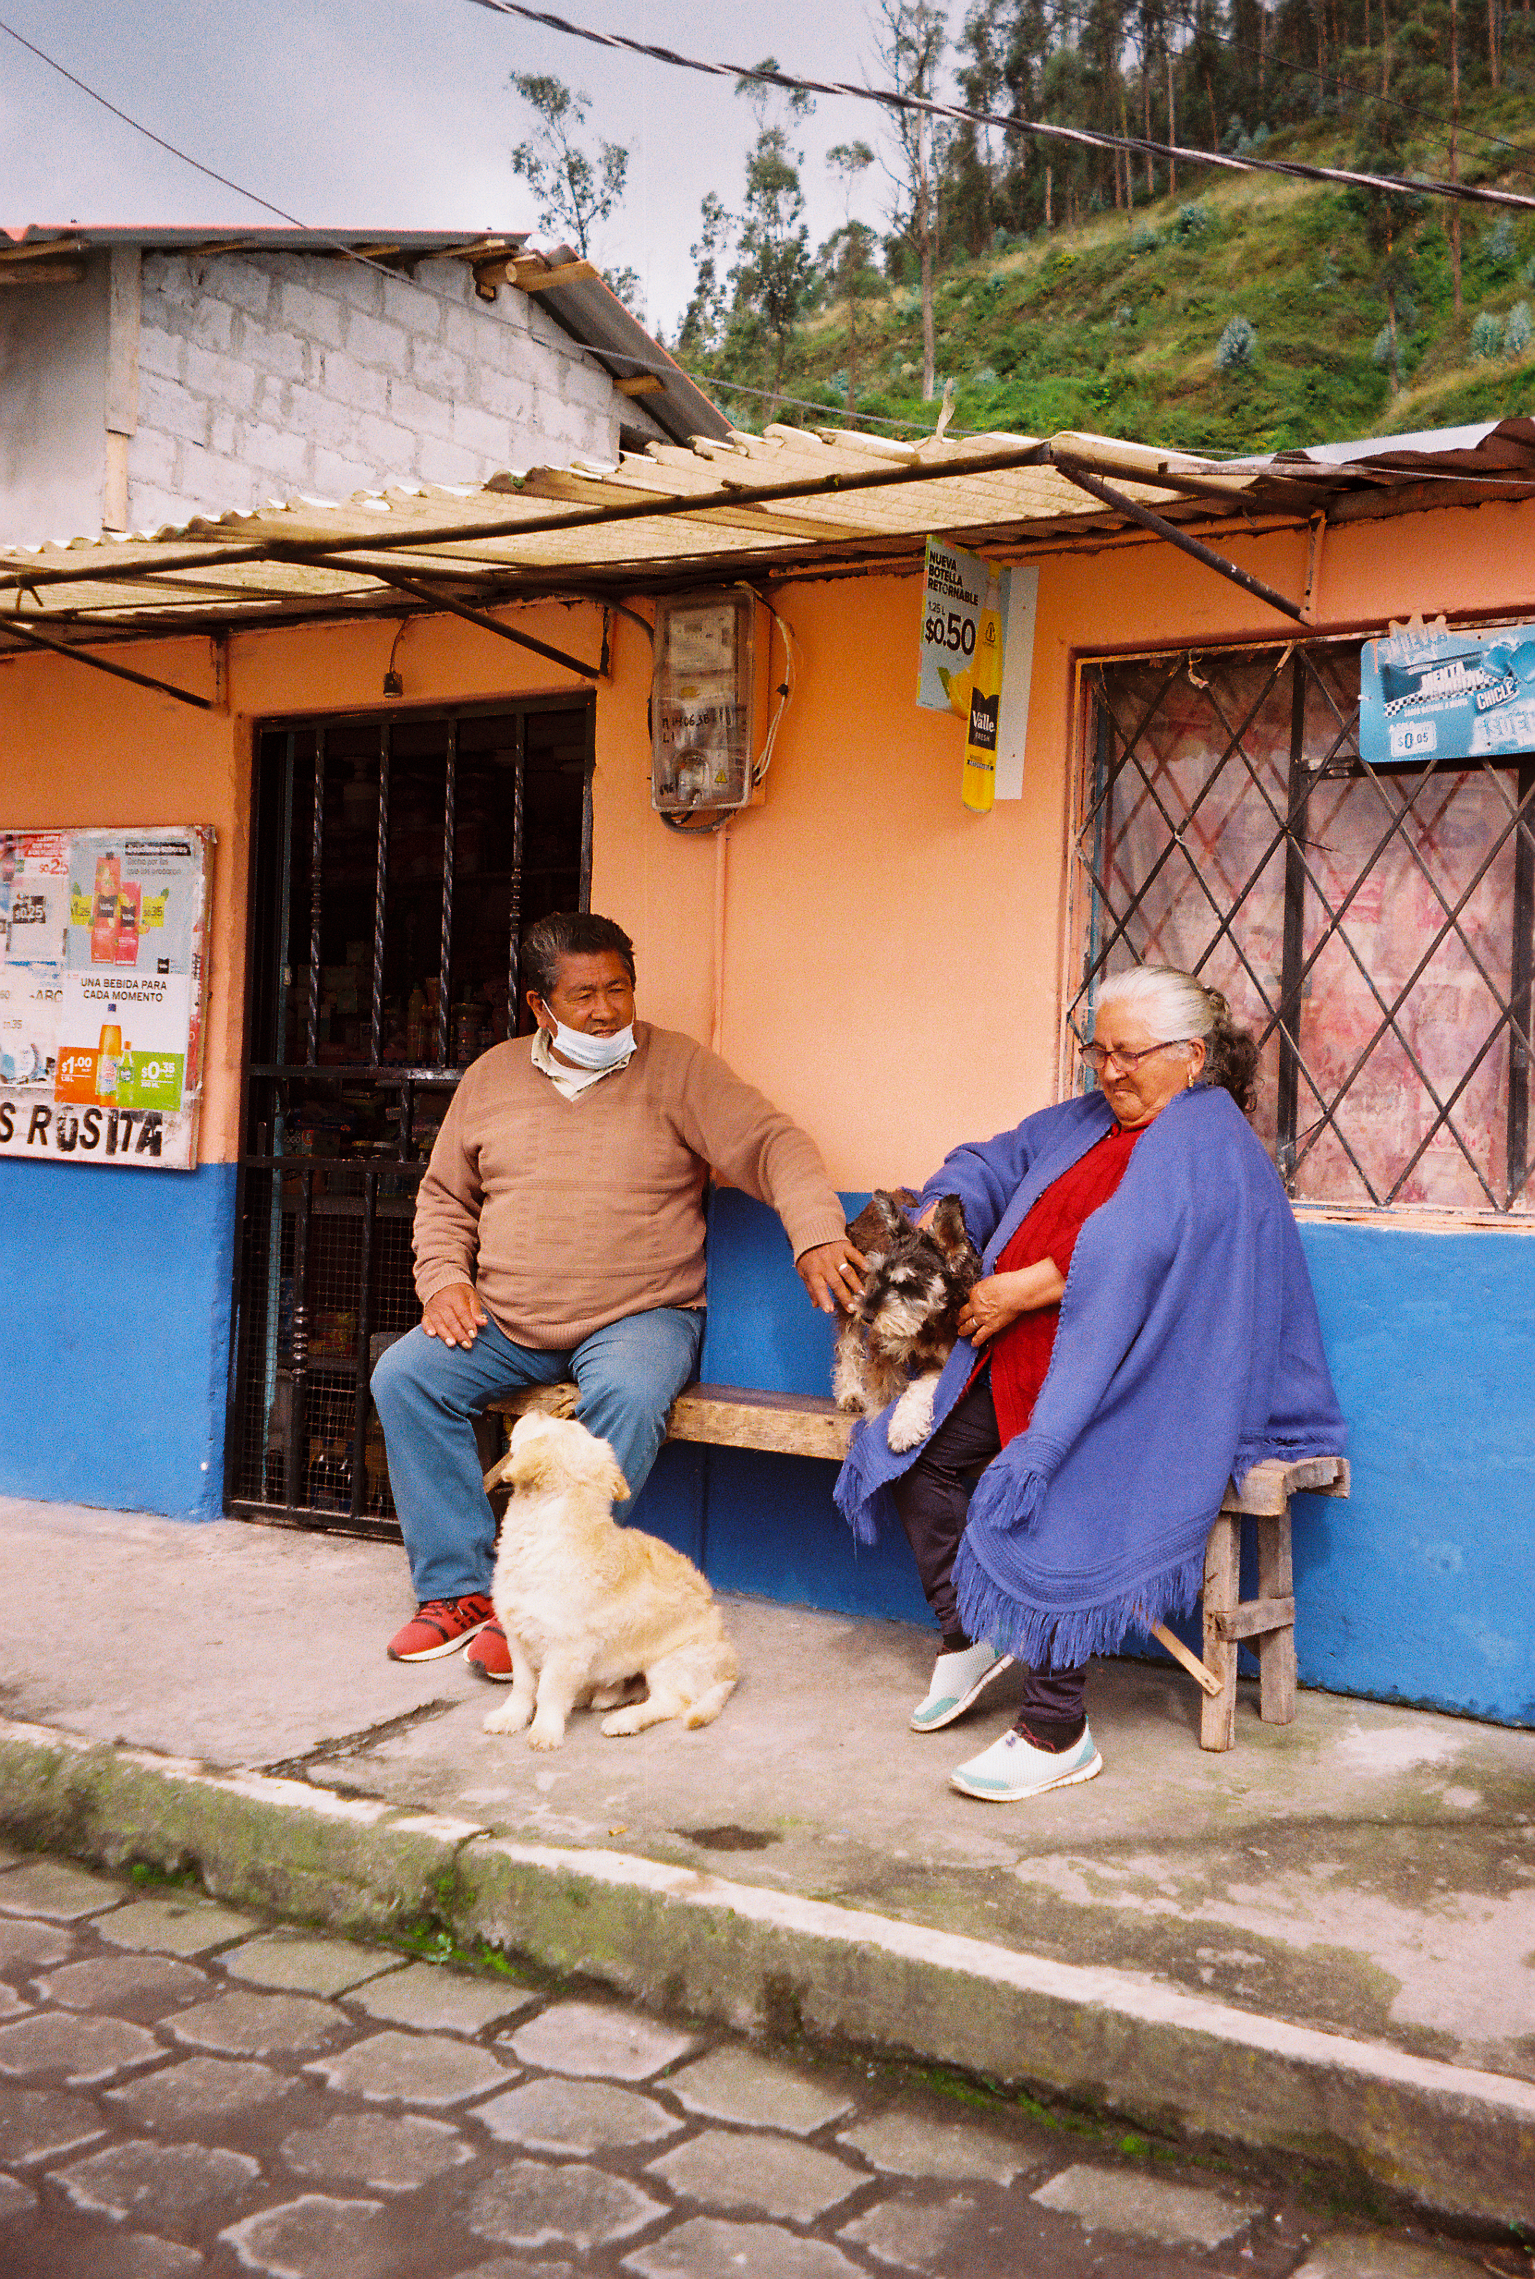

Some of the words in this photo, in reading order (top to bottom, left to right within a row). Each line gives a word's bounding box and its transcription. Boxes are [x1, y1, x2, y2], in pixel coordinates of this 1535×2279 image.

[929, 550, 957, 572] NUEVA
[928, 564, 963, 587] BOTELLA
[927, 577, 979, 606] RETORNABLE
[925, 612, 976, 656] $0.50
[1422, 661, 1466, 684] MENTA
[1476, 681, 1516, 710] CHICLE
[972, 710, 995, 733] Valle
[1397, 732, 1430, 749] $0.05
[15, 904, 44, 919] $0.25
[81, 977, 101, 988] UNA
[103, 978, 139, 989] BEBIDA
[141, 980, 167, 990] PARA
[83, 989, 109, 999] CADA
[112, 991, 163, 1002] MOMENTO
[61, 1056, 92, 1074] $1.00
[141, 1061, 175, 1079] $0.35
[0, 1101, 16, 1143] S
[26, 1104, 164, 1156] ROSITA
